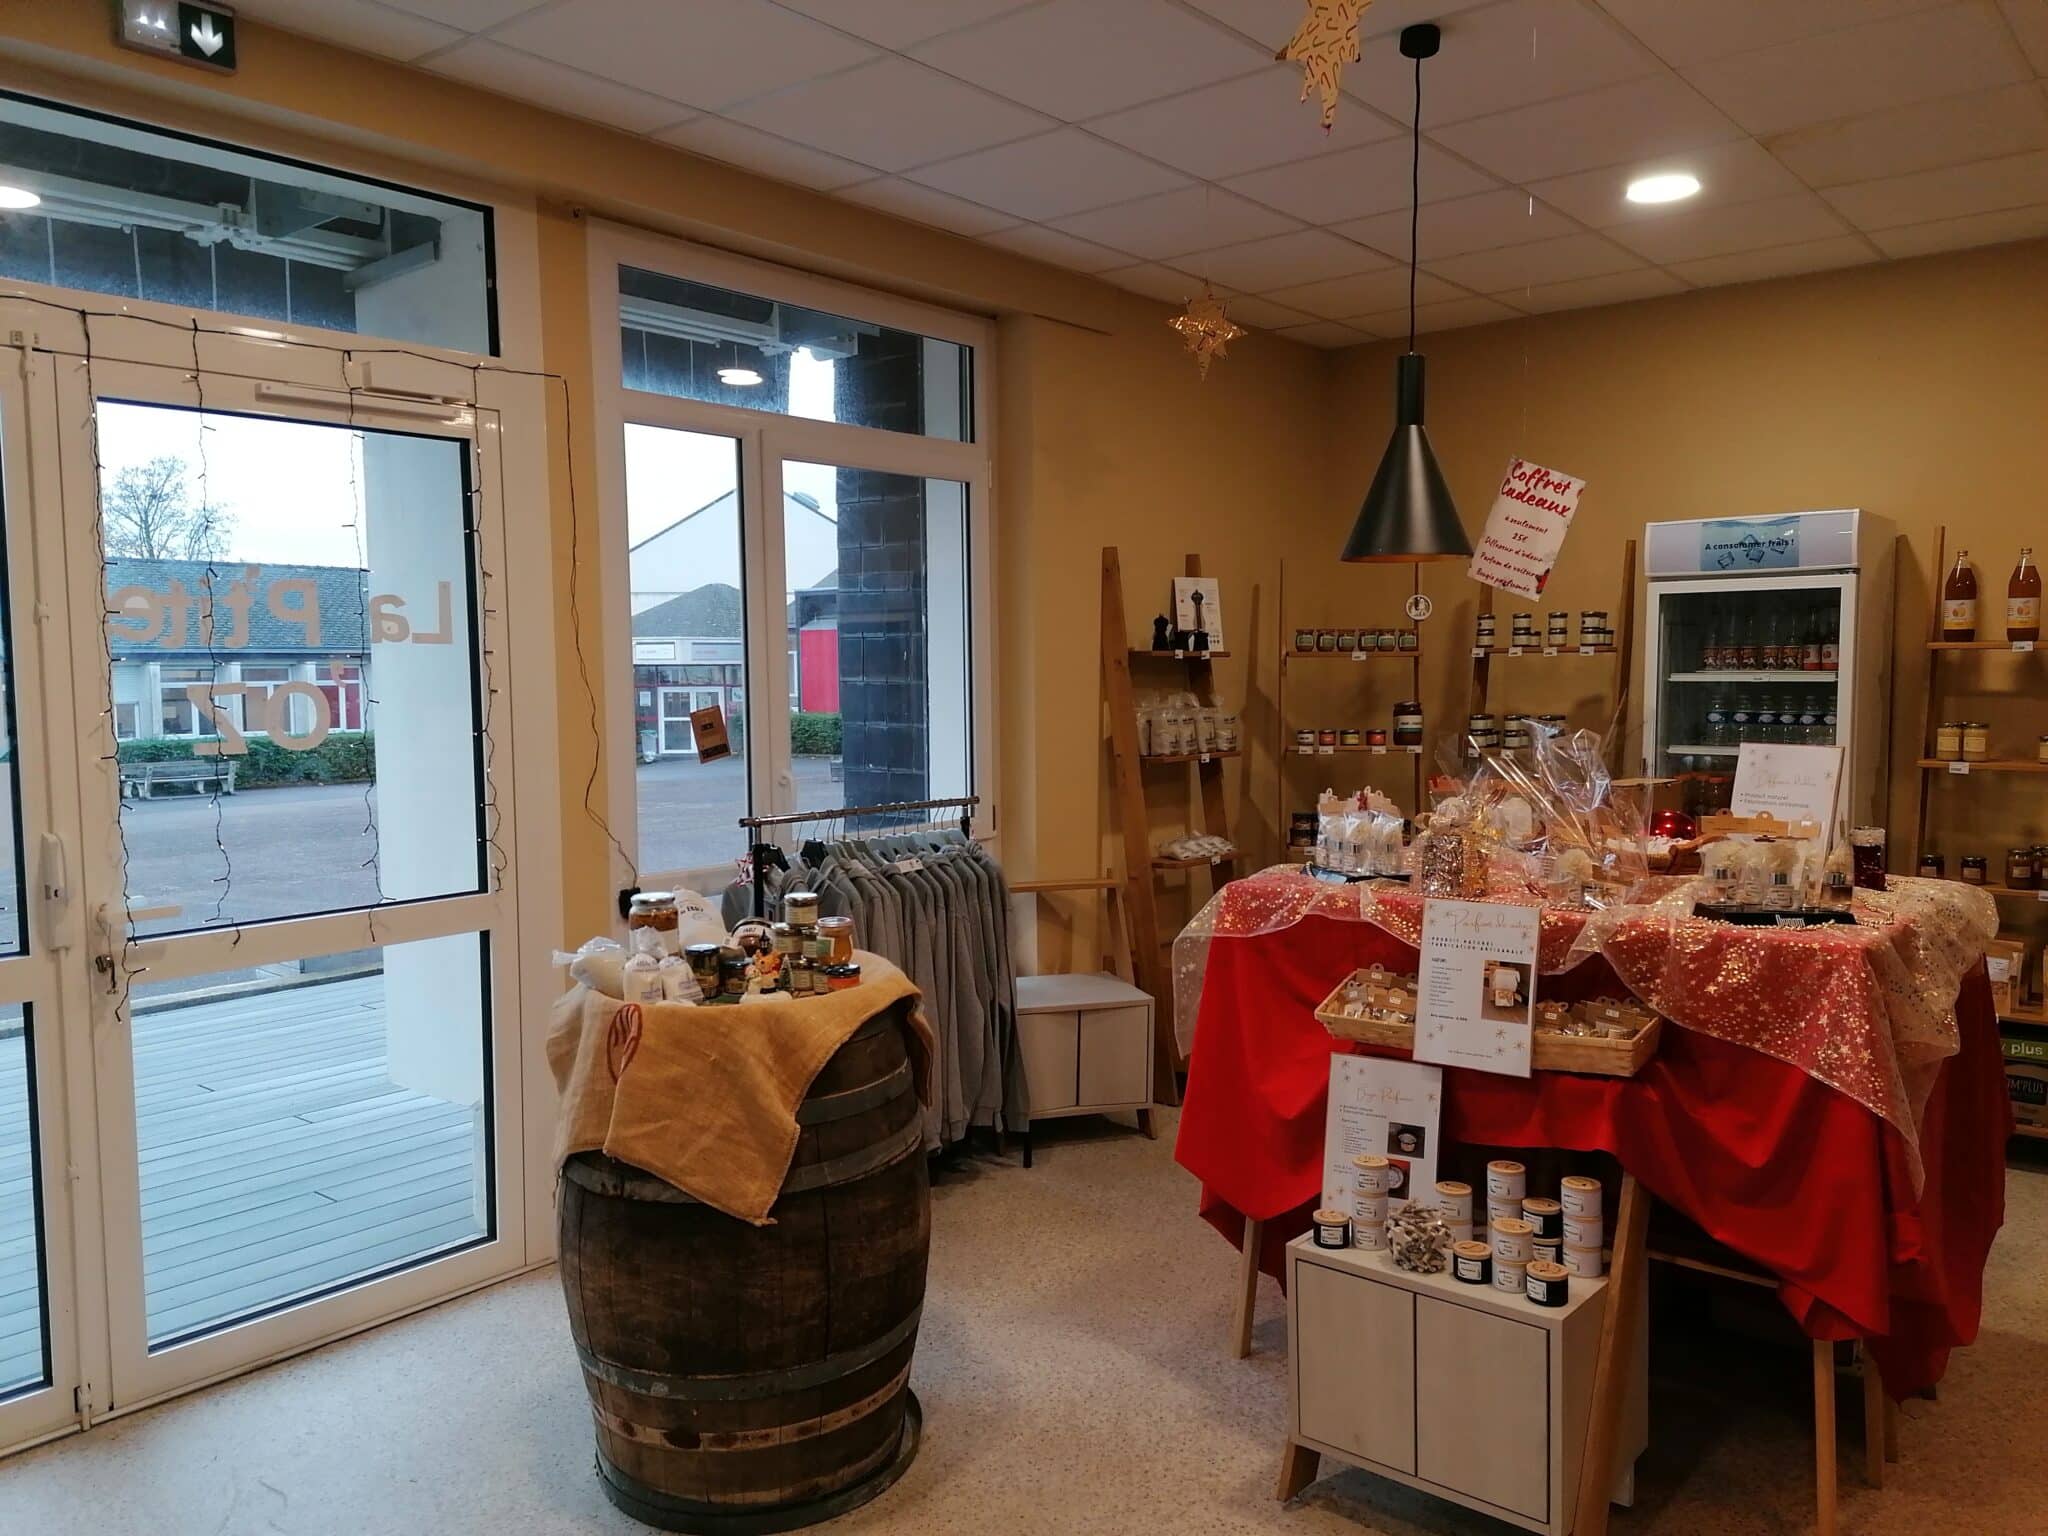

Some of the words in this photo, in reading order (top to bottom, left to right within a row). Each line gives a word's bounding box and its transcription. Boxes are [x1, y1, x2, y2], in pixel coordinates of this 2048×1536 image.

[1511, 461, 1571, 496] Coffret
[1501, 478, 1571, 518] Cadeaux
[1510, 517, 1549, 535] seulement
[1713, 540, 1766, 550] consommer
